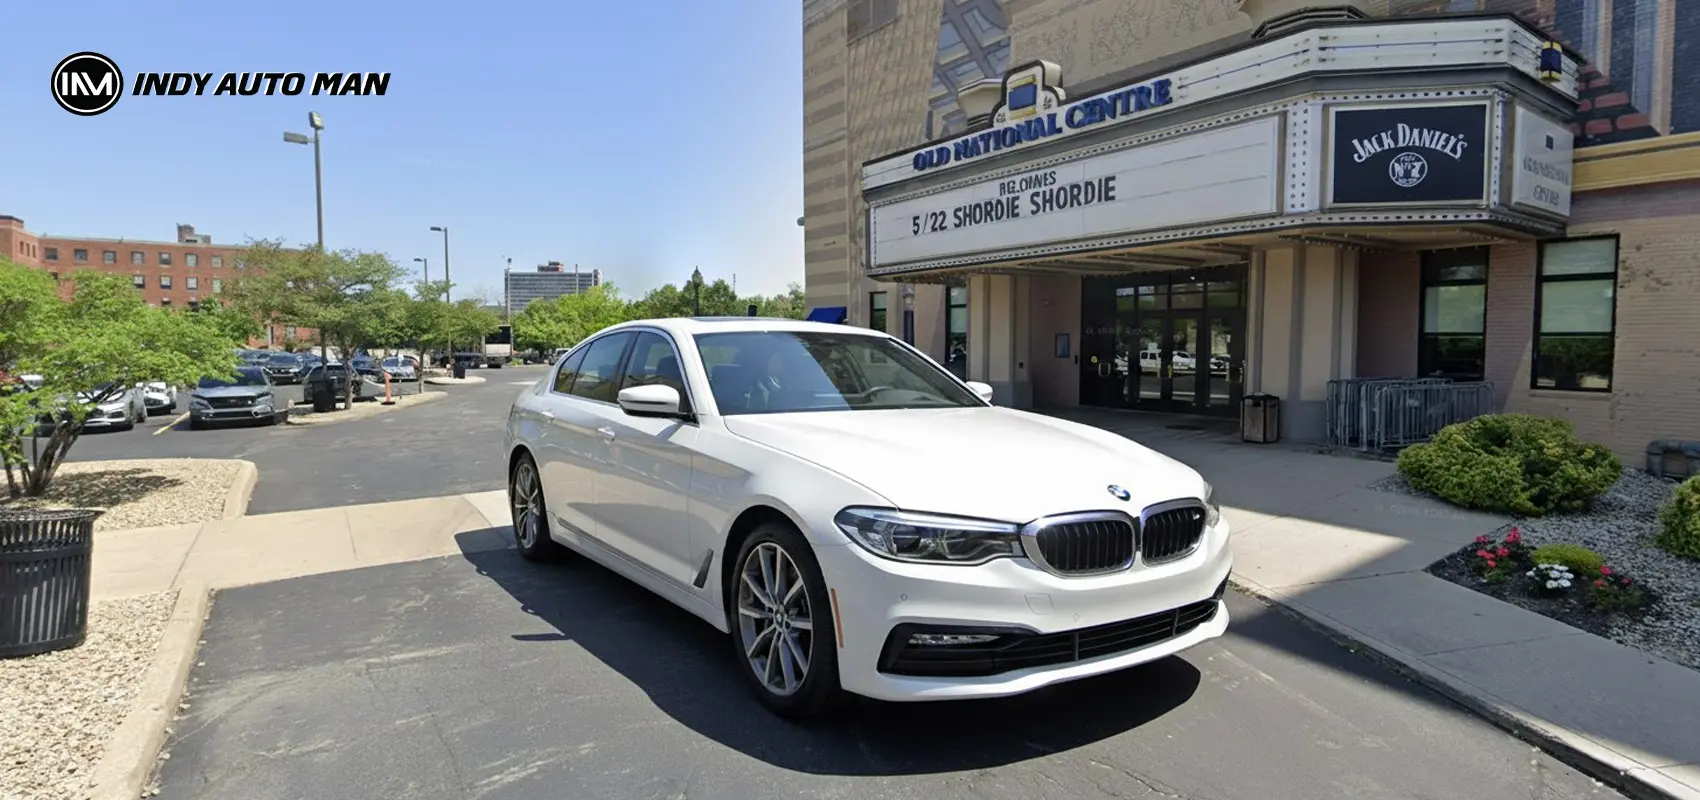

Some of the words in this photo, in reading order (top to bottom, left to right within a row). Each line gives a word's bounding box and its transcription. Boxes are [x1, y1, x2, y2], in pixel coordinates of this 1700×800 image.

[913, 149, 950, 171] OLD
[953, 113, 1063, 161] NATIONAL
[1065, 78, 1173, 129] CENTRE
[1352, 130, 1395, 163] JACK
[1397, 123, 1468, 159] DANIEL'S
[912, 210, 947, 236] 5/22
[953, 195, 1020, 229] SHORDIE
[1030, 175, 1117, 216] SHORDIE
